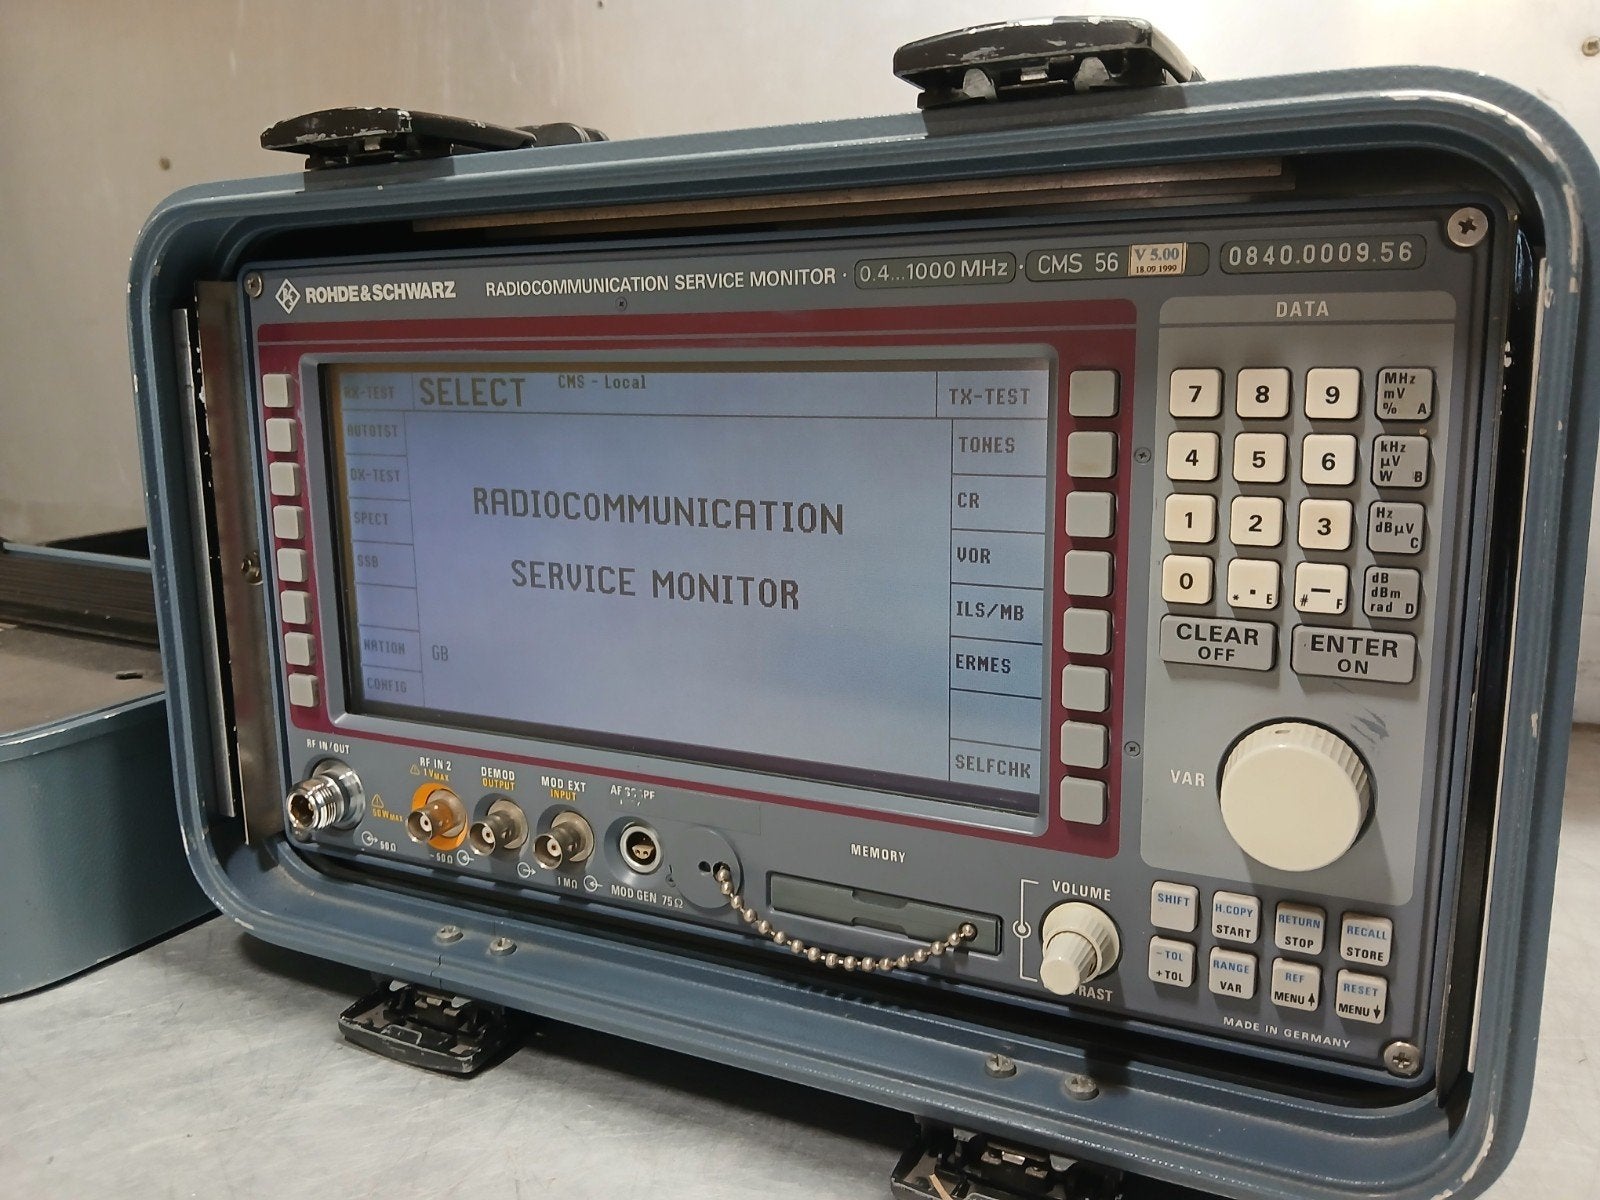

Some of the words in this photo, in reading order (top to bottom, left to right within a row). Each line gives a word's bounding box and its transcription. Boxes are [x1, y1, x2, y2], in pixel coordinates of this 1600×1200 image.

[1134, 248, 1146, 261] V
[1150, 247, 1180, 261] 5.00
[1228, 241, 1413, 266] 0840.0009.56
[961, 258, 1009, 278] MHz
[1037, 254, 1083, 274] CMS
[1095, 252, 1119, 272] 56
[485, 275, 669, 297] RADIOCOMMUNICATION
[674, 272, 744, 290] SERVICE
[749, 267, 836, 288] MONITOR
[305, 280, 456, 304] ROHDE&SCHWARZ
[1276, 301, 1329, 318] DATA
[558, 374, 585, 389] CMS
[605, 374, 647, 390] Local
[1384, 372, 1416, 385] MHz
[419, 377, 526, 408] SELECT
[949, 388, 1030, 405] TX-TEST
[1188, 385, 1202, 403] 7
[1255, 385, 1270, 404] 8
[1325, 386, 1340, 404] 9
[1383, 388, 1405, 399] mV
[1383, 402, 1397, 415] %
[1417, 402, 1427, 414] A
[959, 437, 1015, 454] TONES
[1380, 440, 1406, 453] kHz
[1185, 449, 1199, 466] 4
[1252, 451, 1266, 468] 5
[1321, 452, 1336, 470] 6
[1379, 471, 1393, 482] W
[1414, 471, 1423, 482] B
[957, 492, 980, 508] CR
[353, 512, 389, 526] SPECT
[473, 487, 844, 536] RADIOCOMMUNICATION
[1376, 507, 1393, 519] Hz
[1184, 512, 1193, 529] 1
[1249, 514, 1263, 532] 2
[1317, 517, 1332, 535] 3
[1410, 536, 1419, 549] C
[357, 554, 379, 568] SSB
[957, 546, 991, 564] VOR
[510, 559, 636, 597] SERVICE
[652, 569, 799, 610] MONITOR
[1179, 572, 1194, 590] 0
[1371, 572, 1389, 584] dB
[1266, 594, 1273, 605] E
[1300, 594, 1309, 607] #
[1370, 586, 1401, 600] dBm
[956, 600, 1025, 621] ILS/MB
[1336, 598, 1344, 610] F
[1370, 600, 1393, 613] rad
[1405, 603, 1414, 615] D
[1176, 622, 1260, 646] CLEAR
[431, 645, 449, 662] GB
[1197, 646, 1236, 662] OFF
[1310, 633, 1399, 659] ENTER
[955, 653, 1012, 674] ERMES
[1337, 658, 1369, 675] ON
[306, 738, 316, 748] RF
[319, 740, 350, 754] IN/OUT
[419, 756, 431, 767] RF
[433, 758, 444, 769] IN
[445, 761, 452, 772] 2
[954, 753, 1031, 779] SELFCHK
[481, 766, 515, 781] DEMOD
[1170, 769, 1205, 787] VAR
[482, 777, 515, 791] OUTPUT
[541, 776, 564, 789] MOD
[567, 780, 587, 792] EXT
[550, 788, 577, 801] INPUT
[851, 843, 907, 863] MEMORY
[611, 884, 634, 899] MOD
[636, 889, 657, 904] GEN
[1052, 880, 1112, 902] VOLUME
[1157, 893, 1191, 907] SHIFT
[1215, 903, 1254, 918] H.COPY
[1278, 913, 1321, 929] RETURN
[1216, 924, 1252, 939] START
[1346, 925, 1387, 941] RECALL
[1284, 935, 1315, 949] STOP
[1346, 947, 1385, 962] STORE
[1213, 959, 1250, 975] RANGE
[1285, 972, 1306, 984] REF
[1219, 980, 1243, 994] VAR
[1343, 983, 1379, 998] RESET
[1274, 991, 1306, 1006] MENU
[1338, 1003, 1371, 1018] MENU
[1223, 1016, 1260, 1033] MADE
[1265, 1024, 1279, 1036] IN
[1283, 1028, 1351, 1050] GERMANY
